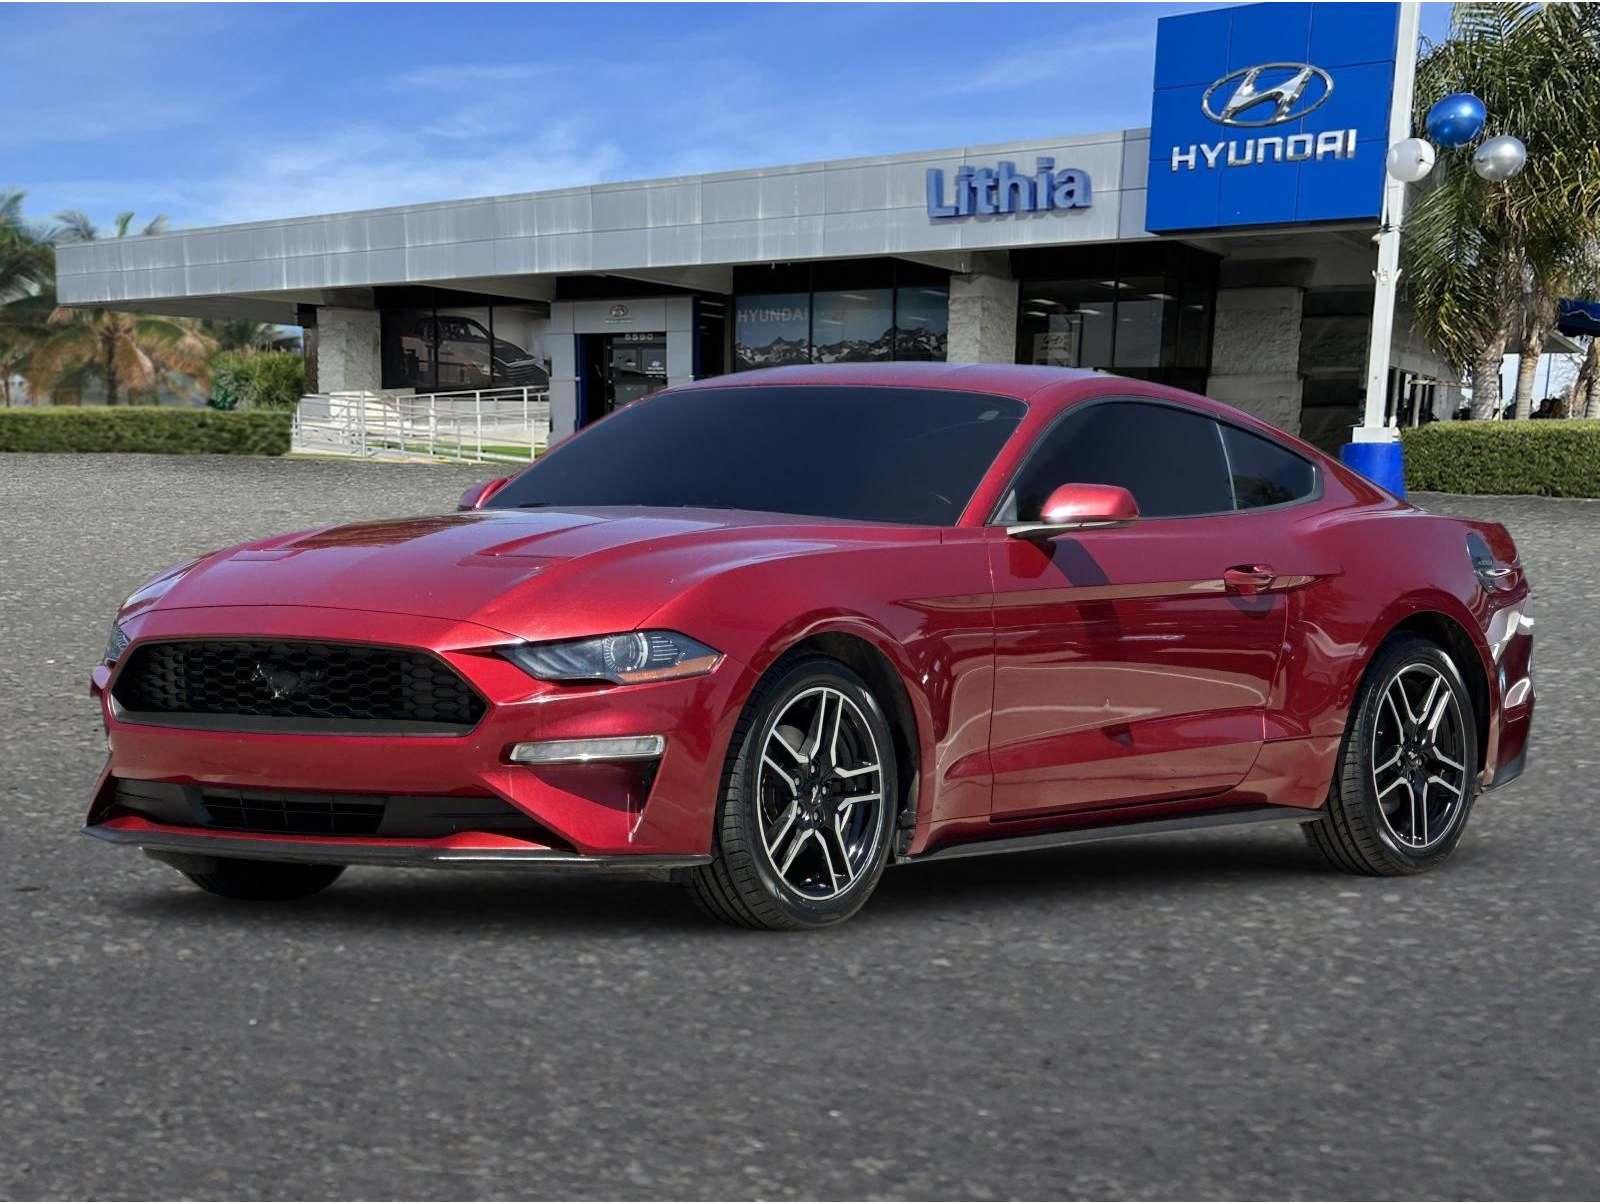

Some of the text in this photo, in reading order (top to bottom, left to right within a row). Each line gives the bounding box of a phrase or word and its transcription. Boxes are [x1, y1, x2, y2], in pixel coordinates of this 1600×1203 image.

[1171, 128, 1357, 172] HYUNDAI
[926, 156, 1092, 218] Lithia
[737, 307, 809, 323] HYUNDAI
